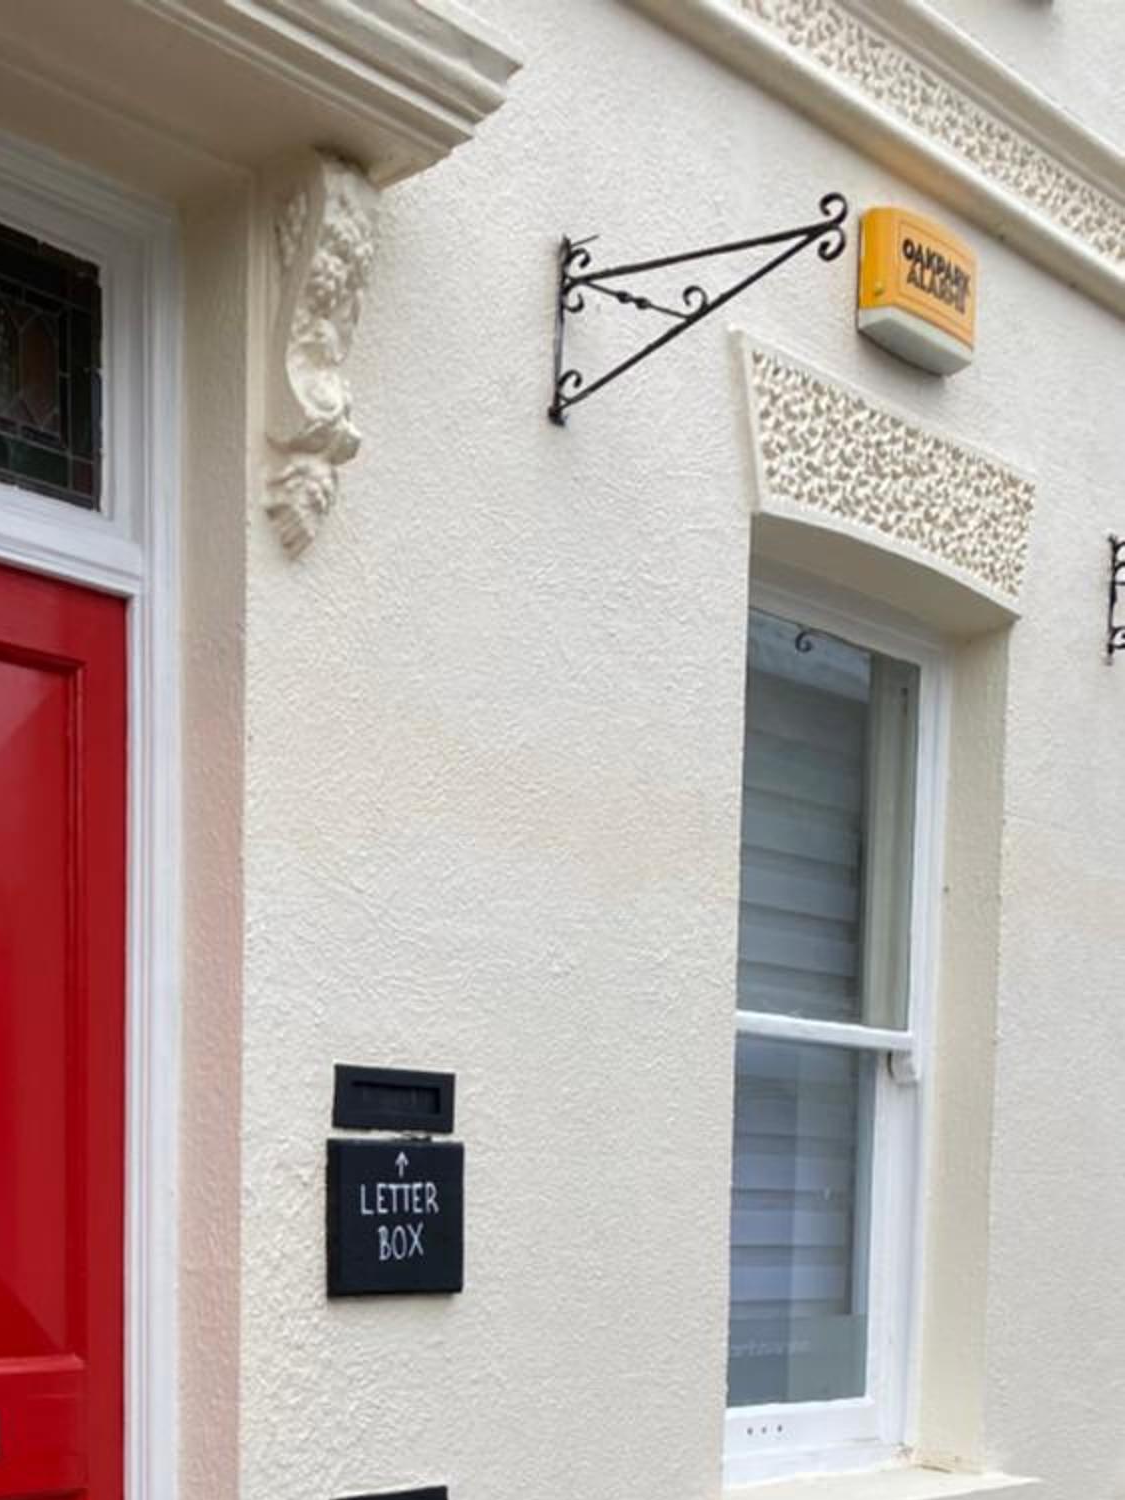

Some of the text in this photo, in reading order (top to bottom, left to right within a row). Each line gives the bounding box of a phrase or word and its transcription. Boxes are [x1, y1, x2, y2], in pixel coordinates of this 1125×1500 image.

[902, 238, 971, 298] OAKPARK
[360, 1182, 439, 1215] LETTER
[377, 1222, 424, 1261] BOX
